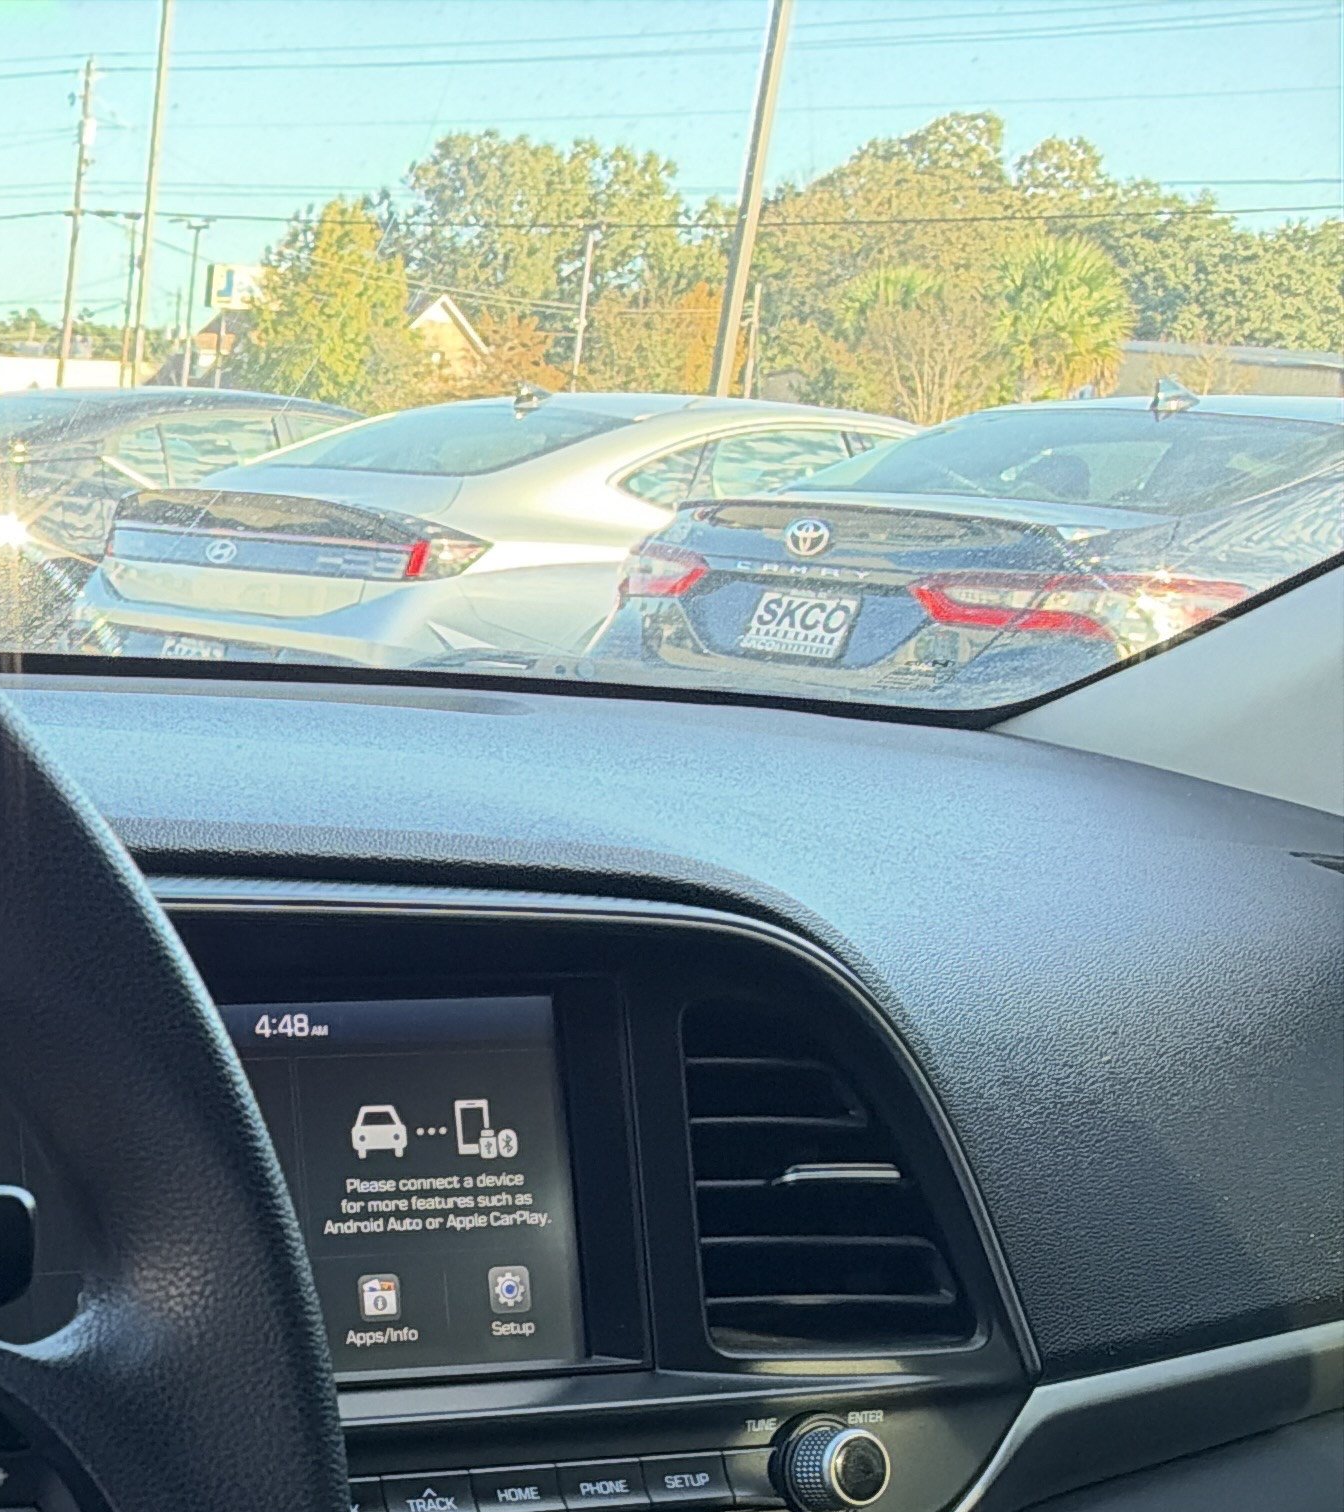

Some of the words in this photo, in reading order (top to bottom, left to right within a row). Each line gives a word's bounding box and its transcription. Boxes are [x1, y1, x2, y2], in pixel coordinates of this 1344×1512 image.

[736, 561, 872, 580] CAMRY
[757, 597, 851, 634] SKCO
[345, 1177, 396, 1194] Please
[398, 1175, 460, 1191] connect
[463, 1178, 472, 1188] a
[476, 1171, 524, 1188] device
[341, 1198, 365, 1214] for
[367, 1199, 409, 1213] more
[411, 1194, 475, 1211] features
[477, 1191, 513, 1208] such
[514, 1193, 533, 1206] as
[324, 1217, 384, 1235] Android
[387, 1216, 422, 1232] Auto
[425, 1217, 444, 1231] or
[446, 1213, 488, 1231] Apple
[490, 1209, 552, 1228] CarPlay.
[345, 1327, 419, 1347] Apps/Info
[491, 1320, 535, 1337] Setup
[745, 1417, 777, 1433] TUNE
[847, 1410, 885, 1426] ENTER
[579, 1478, 630, 1497] PHONE
[664, 1472, 710, 1490] SETUP
[496, 1485, 540, 1503] HOME
[405, 1497, 458, 1512] TRACK
